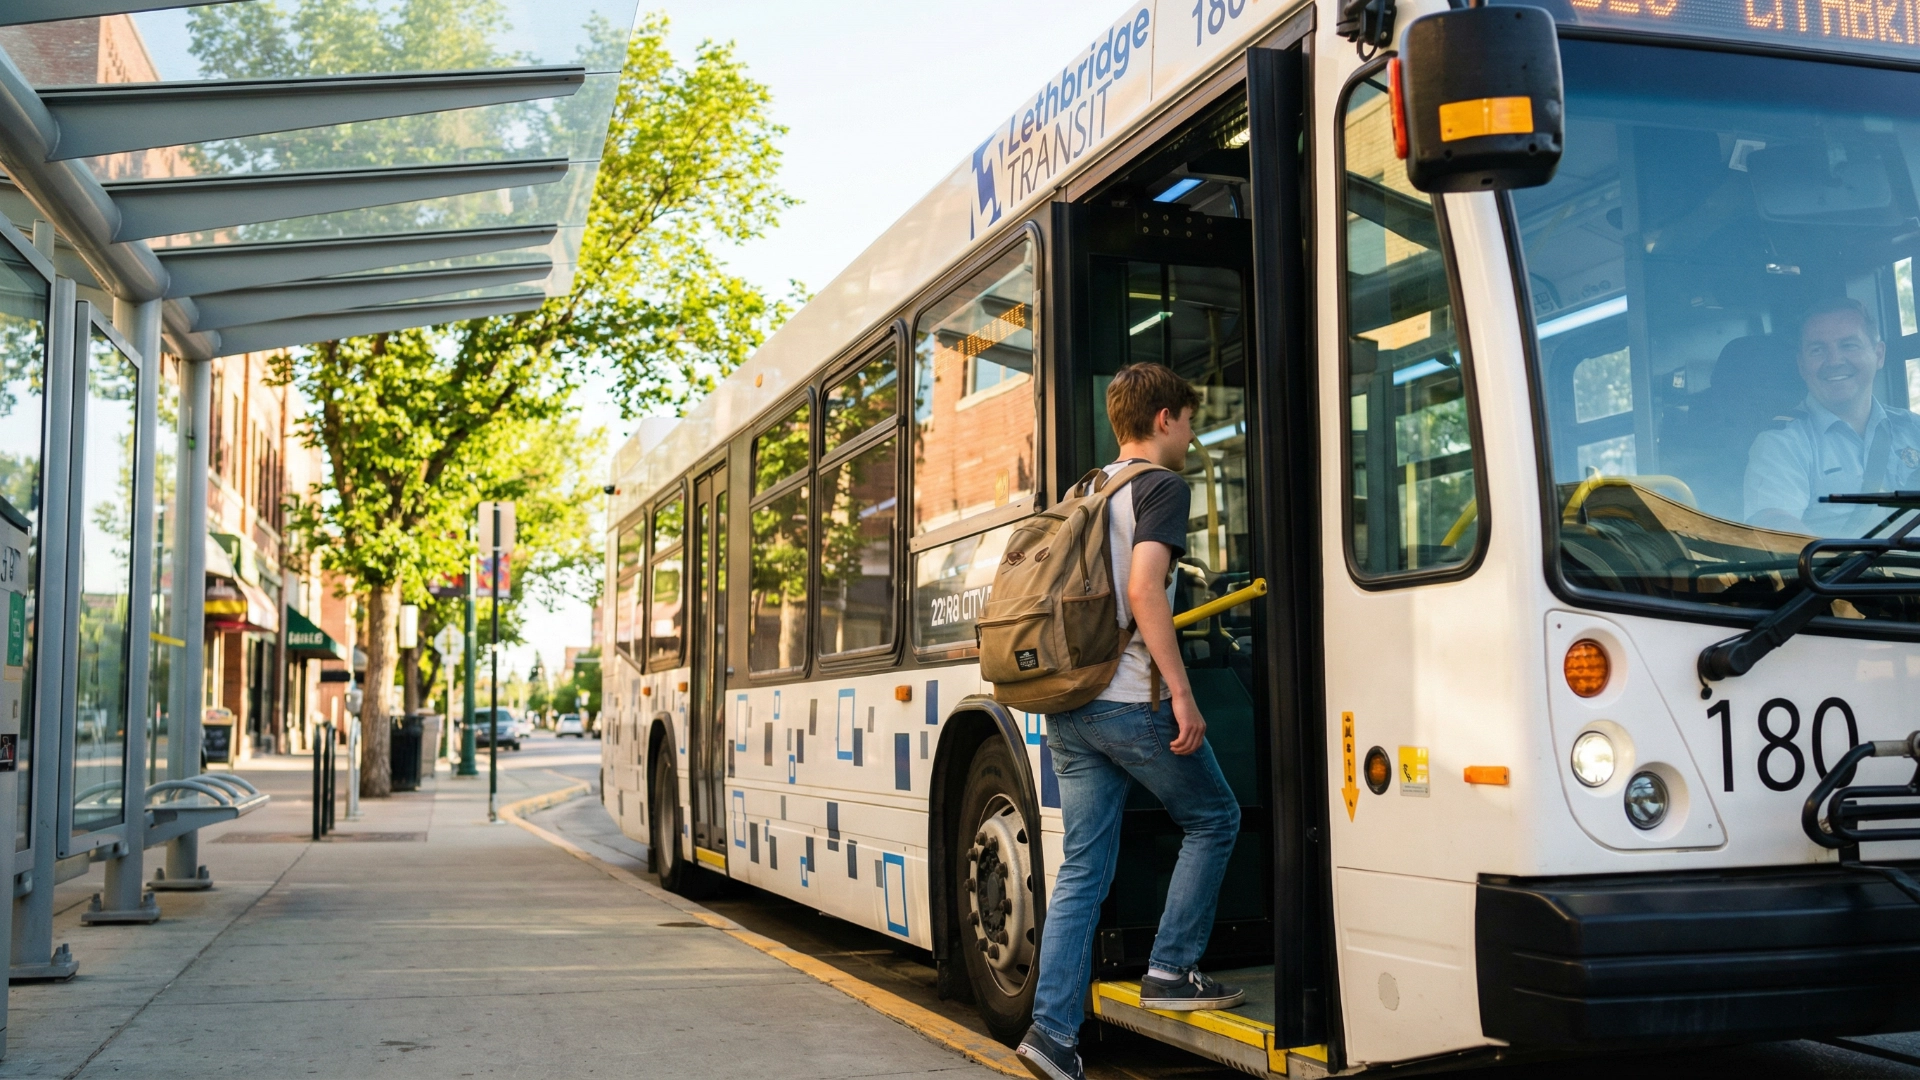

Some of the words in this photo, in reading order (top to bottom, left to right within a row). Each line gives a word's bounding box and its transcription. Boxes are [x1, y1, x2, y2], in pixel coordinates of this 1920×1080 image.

[1007, 79, 1113, 208] TRANSIT
[1008, 8, 1150, 157] Lethbridge
[1706, 697, 1859, 793] 180
